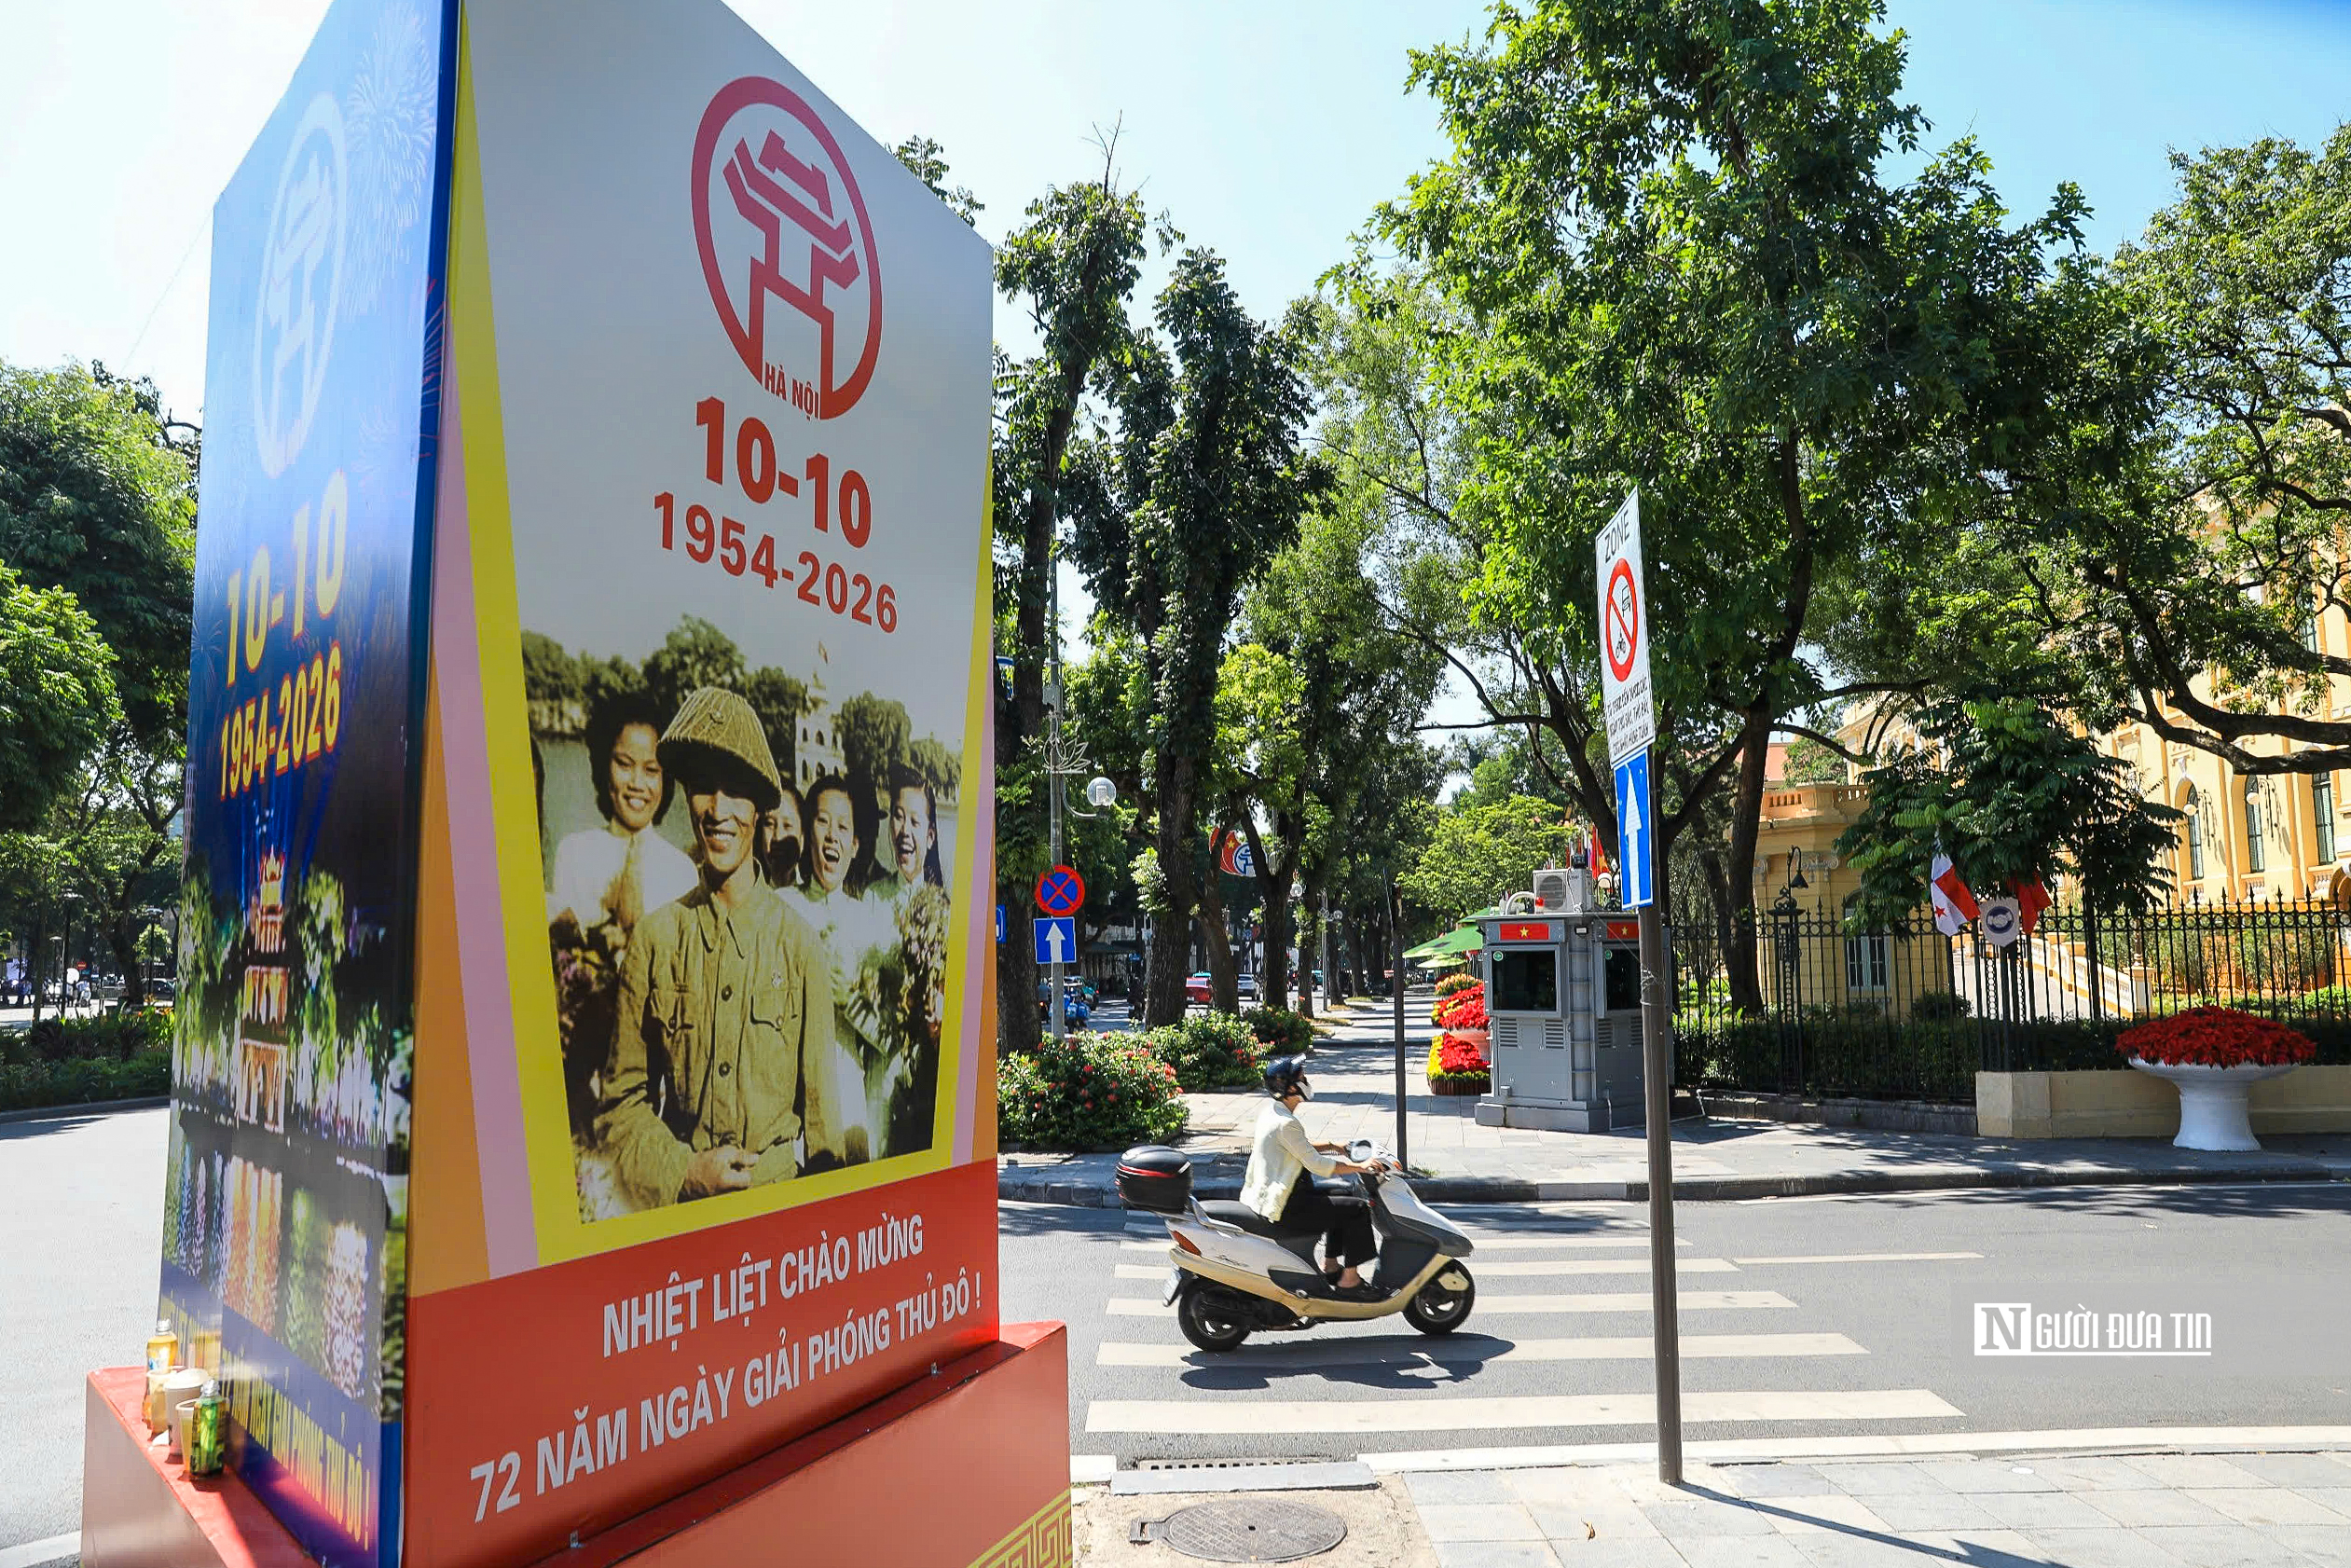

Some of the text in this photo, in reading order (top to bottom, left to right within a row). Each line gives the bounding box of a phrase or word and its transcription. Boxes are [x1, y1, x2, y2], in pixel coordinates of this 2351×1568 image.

[764, 362, 819, 421] HÀ NỘI
[695, 395, 872, 548] 10-10
[1604, 509, 1630, 564] ZONE
[227, 470, 348, 688] 10-10
[654, 490, 898, 634] 1954-2026
[220, 640, 341, 802] 1954-2026
[603, 1213, 924, 1358] NHIỆT LIỆT CHÀO MỪNG
[470, 1451, 521, 1523] 72
[536, 1406, 628, 1496] NĂM
[640, 1366, 735, 1452] NGÀY
[744, 1327, 800, 1408] GIẢI
[809, 1308, 891, 1380] PHÓNG
[896, 1272, 936, 1342] THỦ
[942, 1267, 970, 1323] ĐÔ
